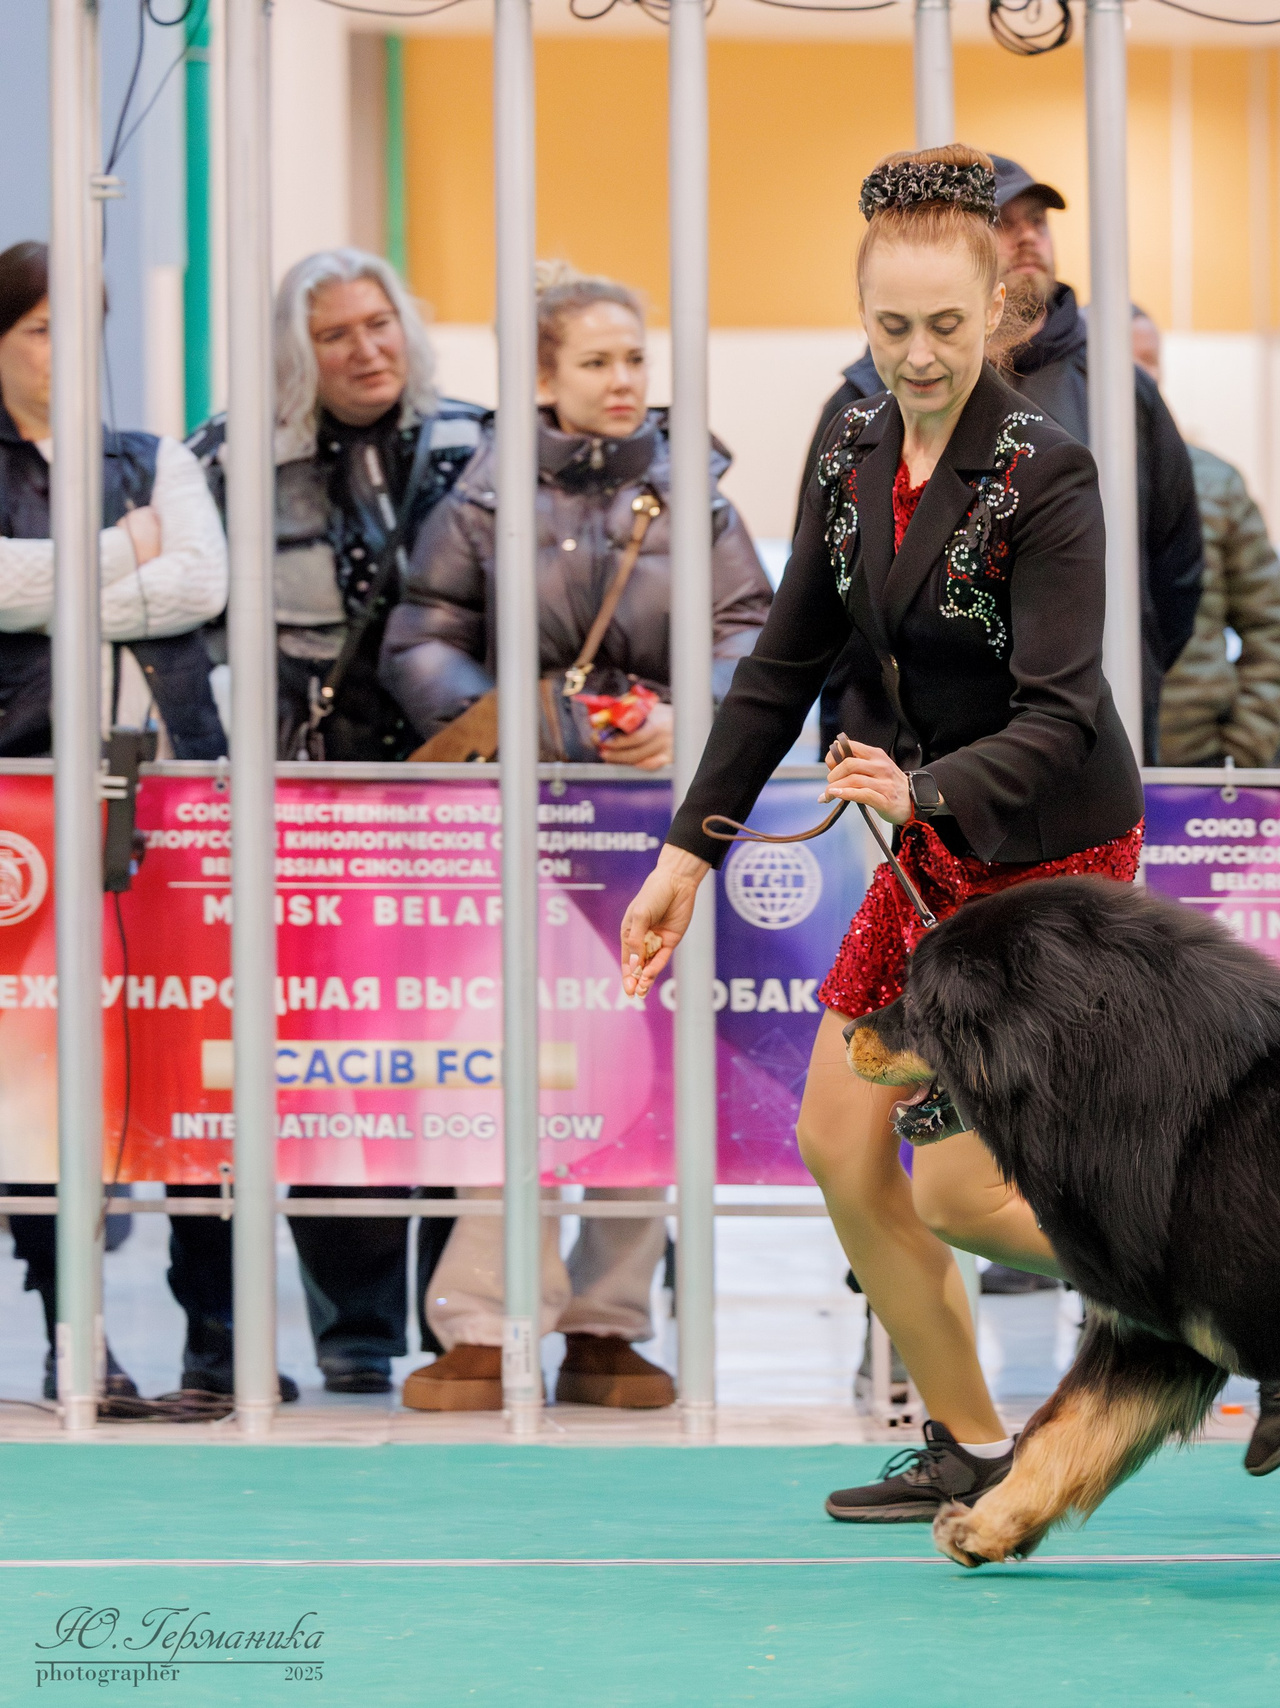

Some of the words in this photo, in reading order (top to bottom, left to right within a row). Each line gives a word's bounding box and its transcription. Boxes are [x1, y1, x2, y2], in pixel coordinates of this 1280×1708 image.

[176, 802, 231, 822] СОЮ
[274, 803, 430, 825] ЩЕСТВЕННЫХ
[435, 800, 595, 826] ОБЪЕДЕНИЙ
[1185, 818, 1256, 838] СОЮЗ
[285, 831, 485, 851] КИНОЛОГИЧЕСКОЕ
[490, 831, 659, 853] ОЕДИНЕНИЕ»
[202, 857, 344, 876] BESSIAN
[348, 858, 496, 877] CINOLOGICAL
[203, 894, 342, 926] MSK
[374, 895, 568, 926] BELARS
[275, 1049, 414, 1085] CACIB
[437, 1050, 495, 1085] FC
[171, 1112, 414, 1141] INTEATIONAL
[424, 1113, 497, 1140] DOG
